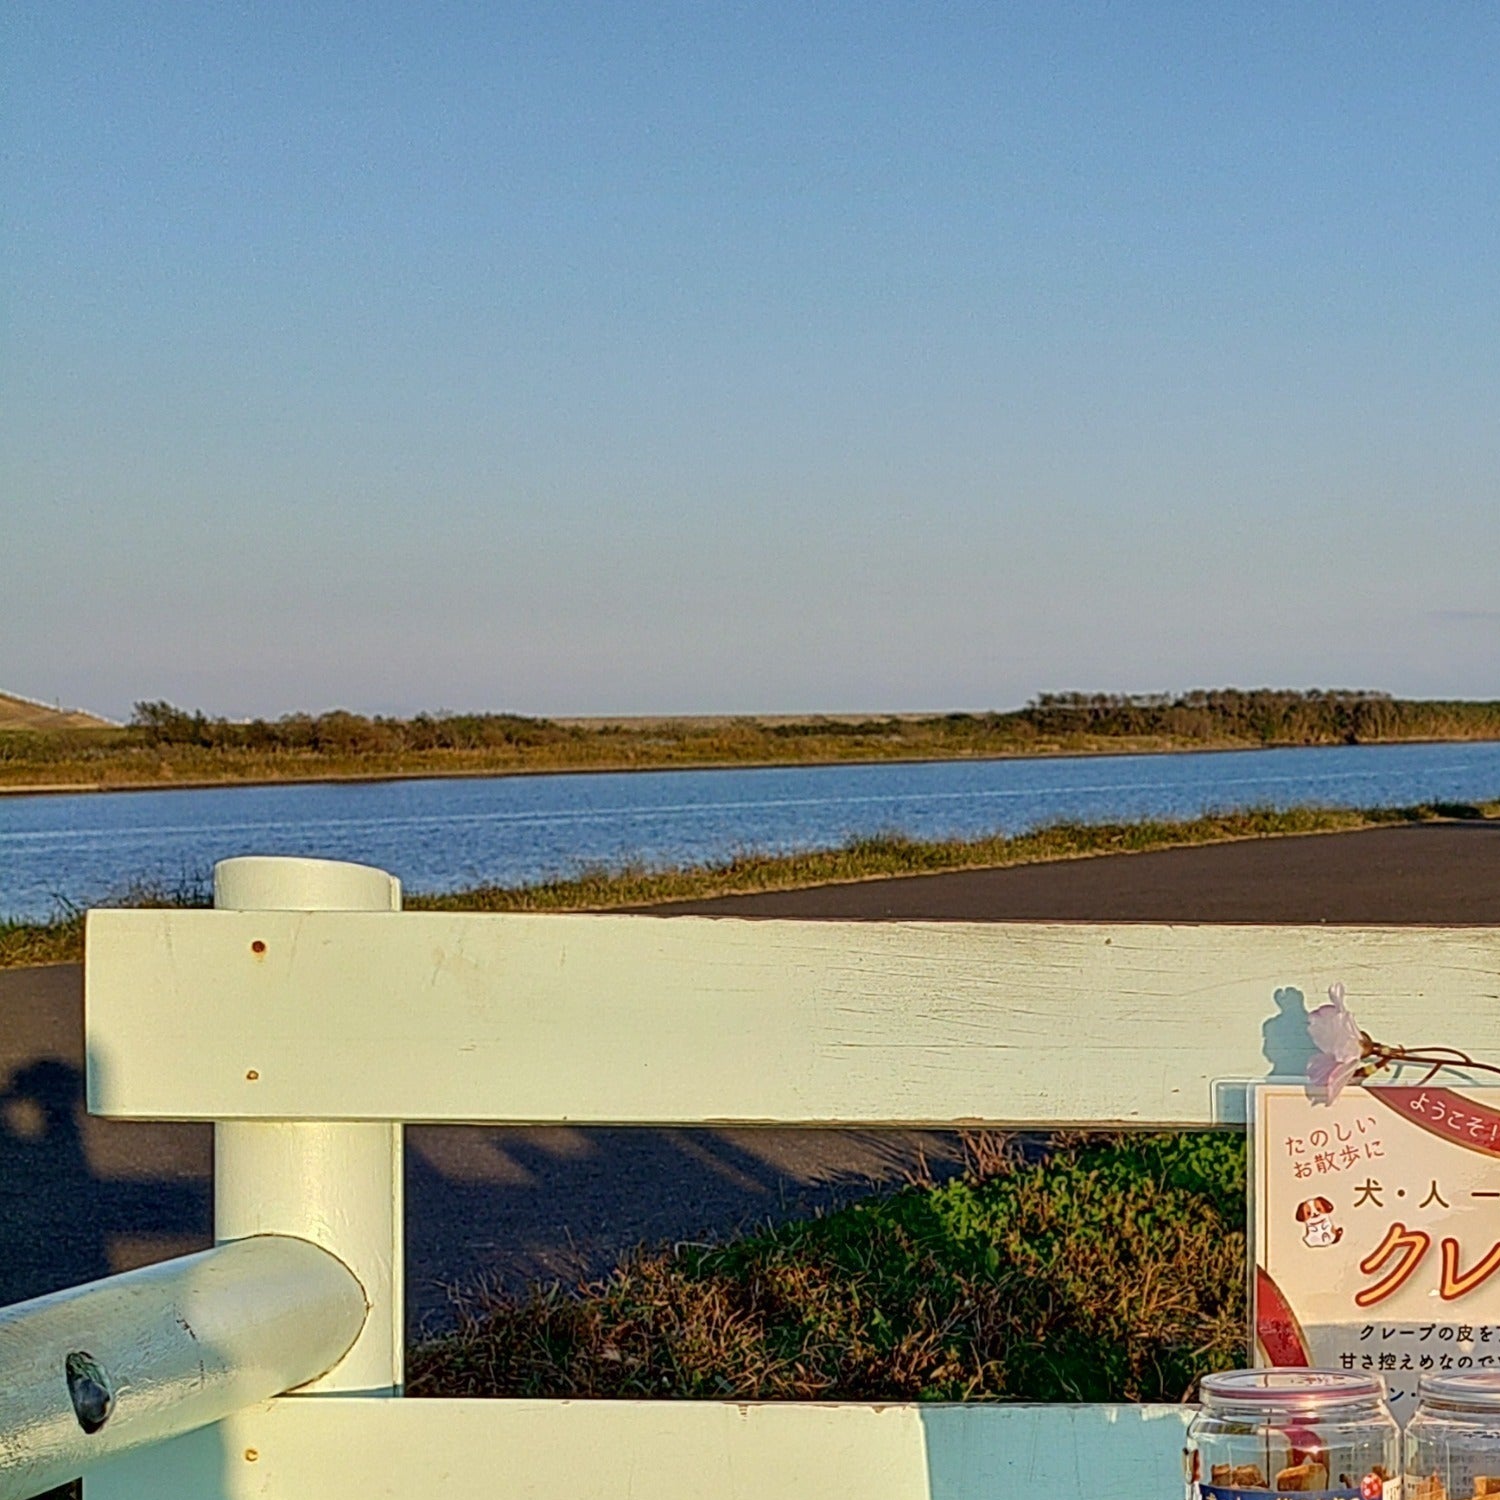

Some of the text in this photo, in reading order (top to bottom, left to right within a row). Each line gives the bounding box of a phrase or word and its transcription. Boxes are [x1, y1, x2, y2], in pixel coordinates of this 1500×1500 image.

[1286, 1117, 1377, 1156] たのしい
[1294, 1141, 1385, 1178] お散歩に
